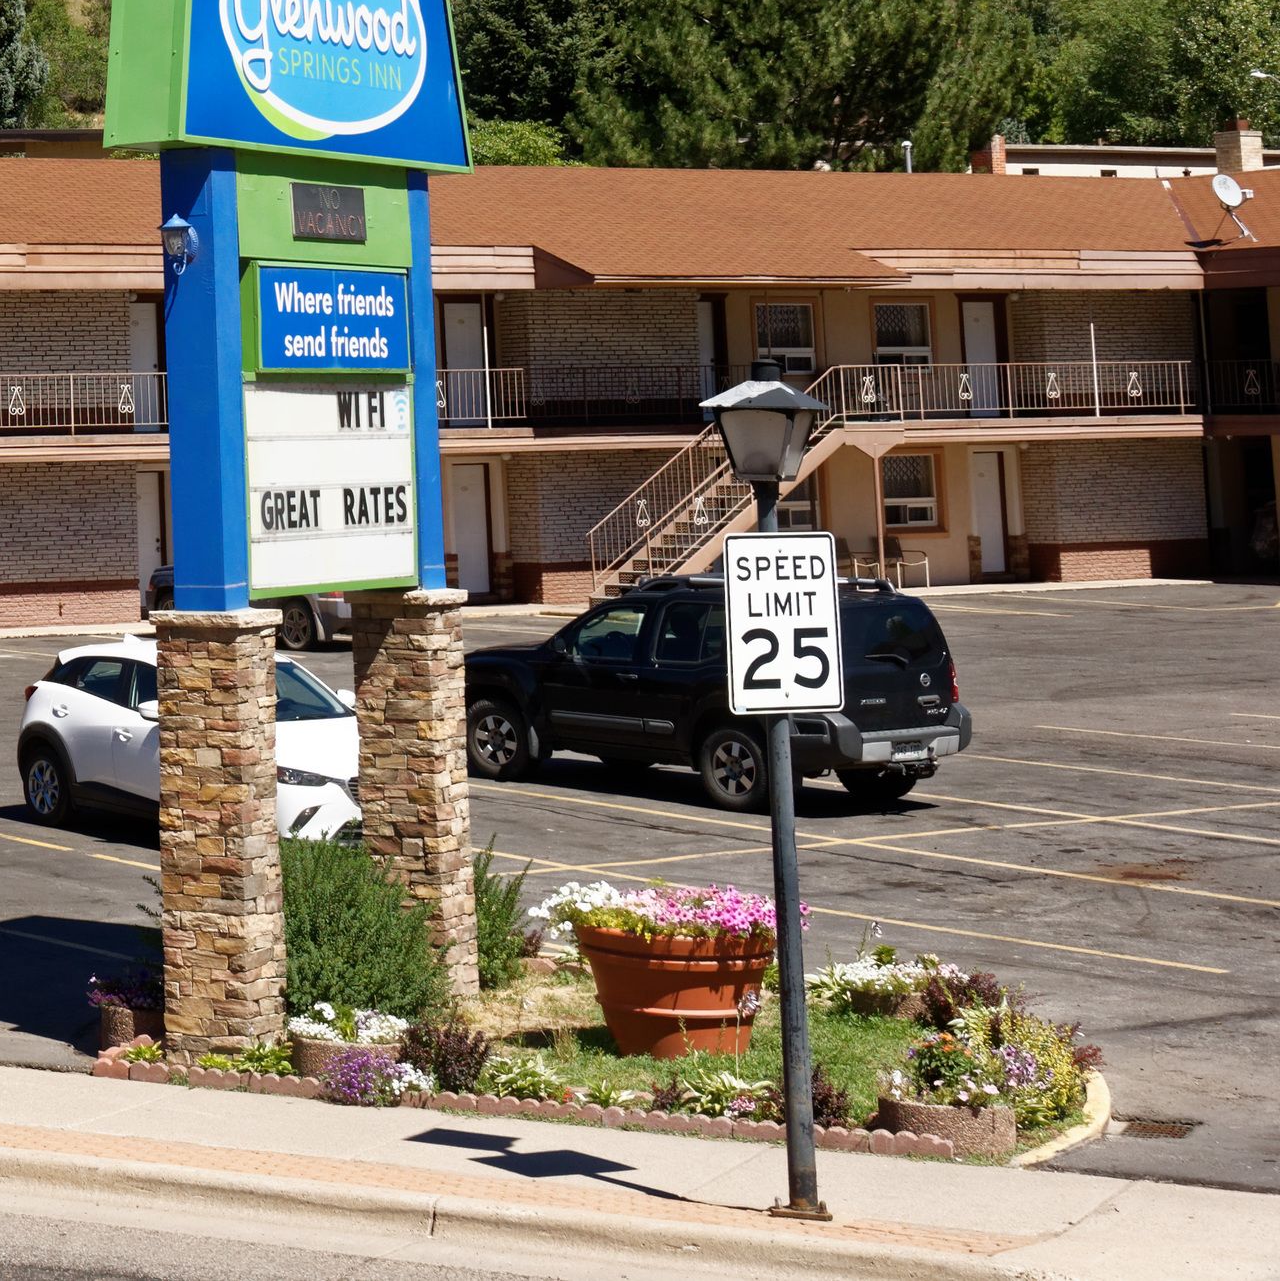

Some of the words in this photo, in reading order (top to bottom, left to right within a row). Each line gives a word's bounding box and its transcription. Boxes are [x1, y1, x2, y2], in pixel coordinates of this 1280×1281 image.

[278, 47, 362, 86] SPRINGS
[369, 66, 403, 92] INN
[319, 187, 341, 210] NO
[296, 211, 365, 238] VACANCY
[274, 281, 333, 315] Where
[337, 283, 395, 318] friends
[284, 326, 326, 358] send
[330, 325, 389, 359] friends
[261, 489, 321, 531] GREAT
[343, 485, 407, 526] RATES
[736, 555, 826, 582] SPEED
[748, 591, 817, 618] LIMIT
[741, 627, 830, 690] 25
